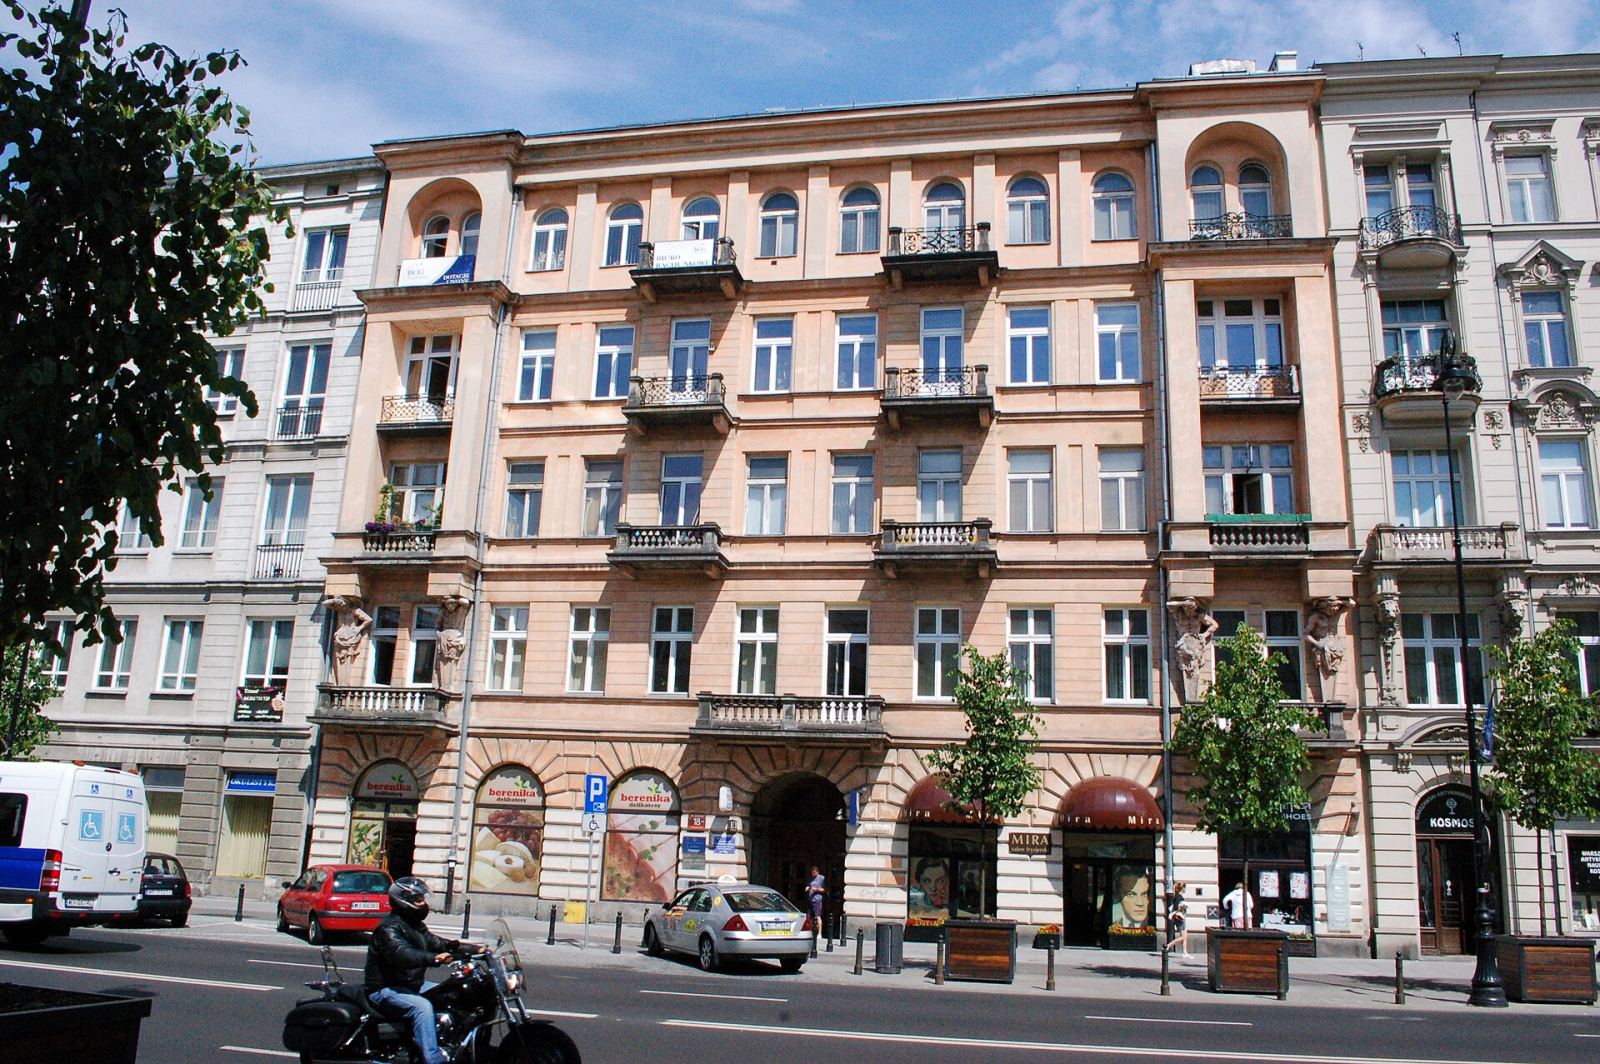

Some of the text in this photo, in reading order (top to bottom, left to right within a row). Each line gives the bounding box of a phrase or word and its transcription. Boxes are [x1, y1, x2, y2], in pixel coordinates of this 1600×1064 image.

[367, 782, 411, 791] berenika
[589, 777, 603, 802] P
[488, 789, 536, 797] berenika
[620, 794, 671, 803] berenika
[1128, 815, 1161, 825] Mira
[1430, 817, 1475, 828] KOSMOS
[1011, 834, 1049, 845] MIRA
